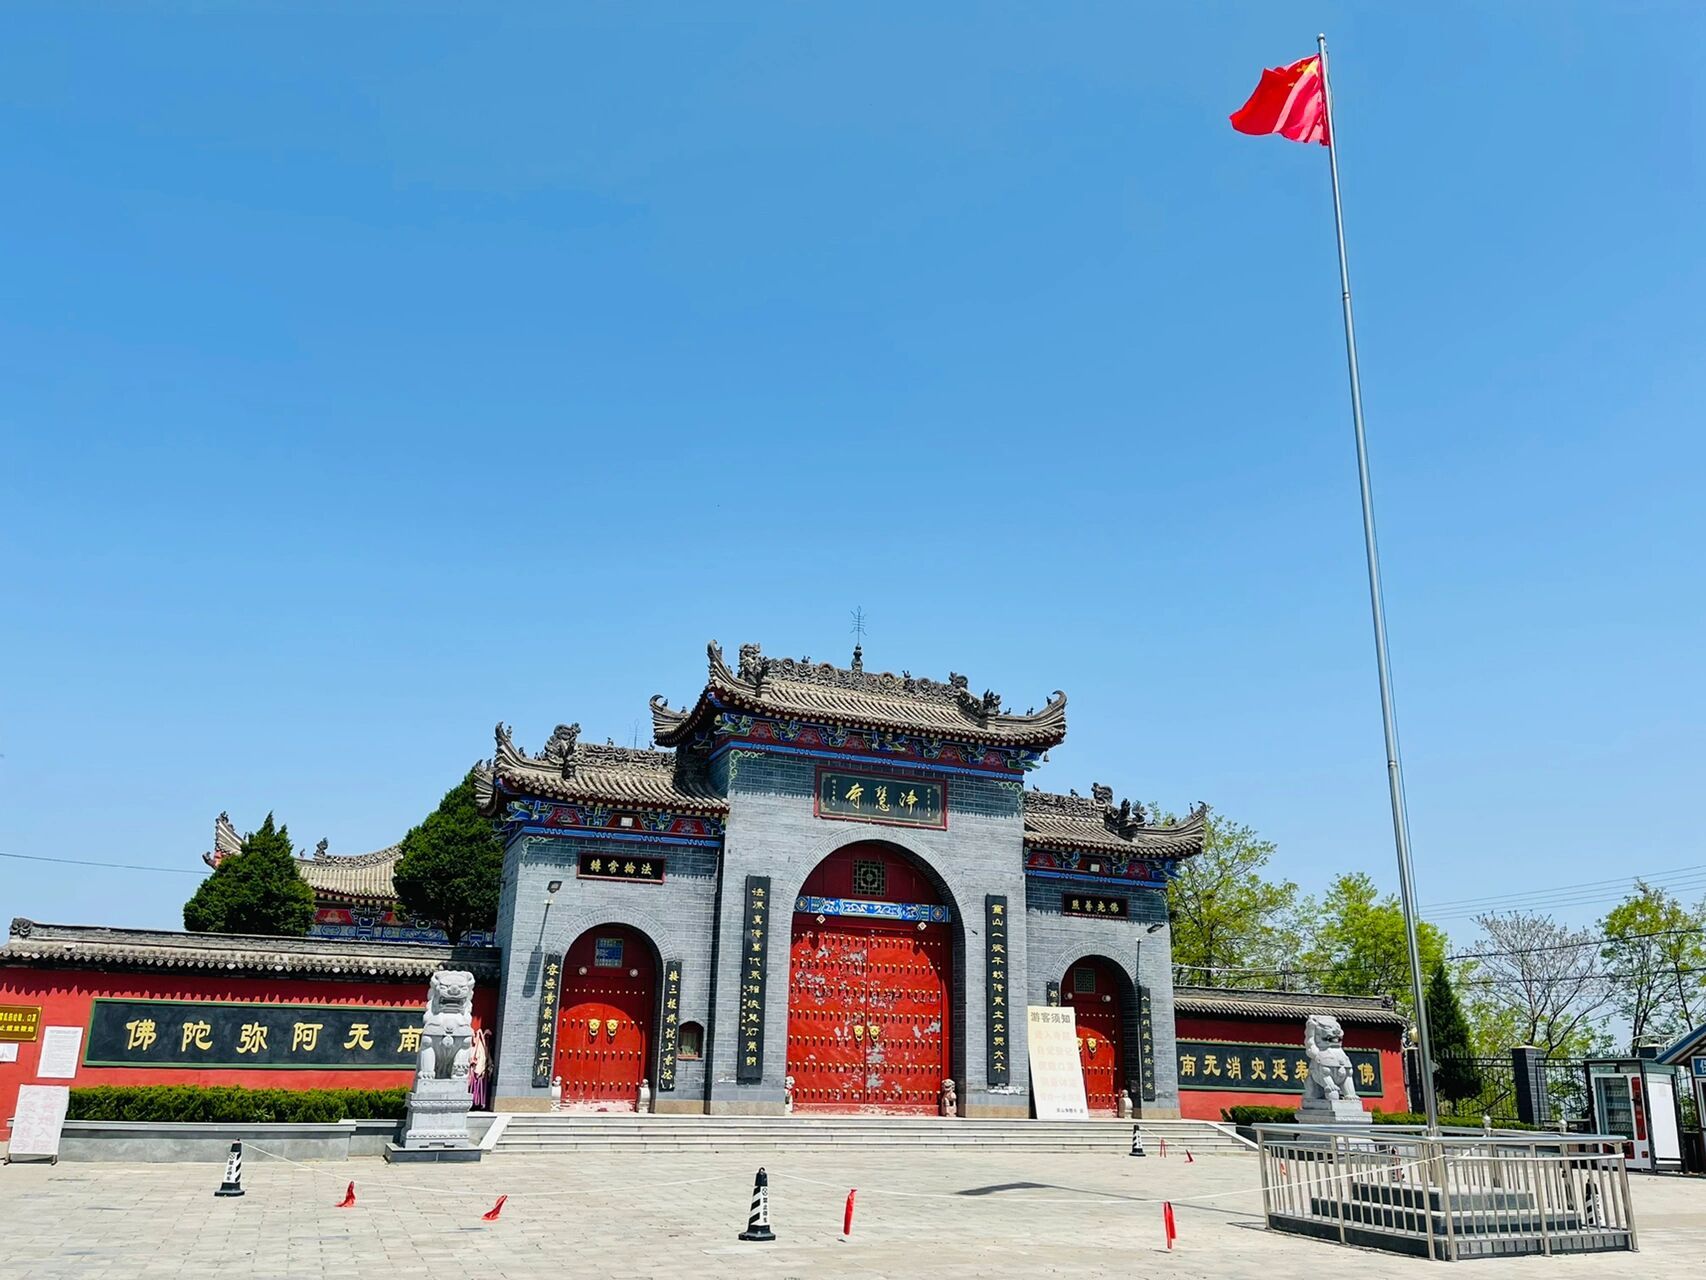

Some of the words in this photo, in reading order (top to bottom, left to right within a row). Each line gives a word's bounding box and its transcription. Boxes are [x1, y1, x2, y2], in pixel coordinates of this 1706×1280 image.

[1030, 1012, 1071, 1024] 游客须知
[1180, 1053, 1375, 1086] 南无消灾延寿佛
